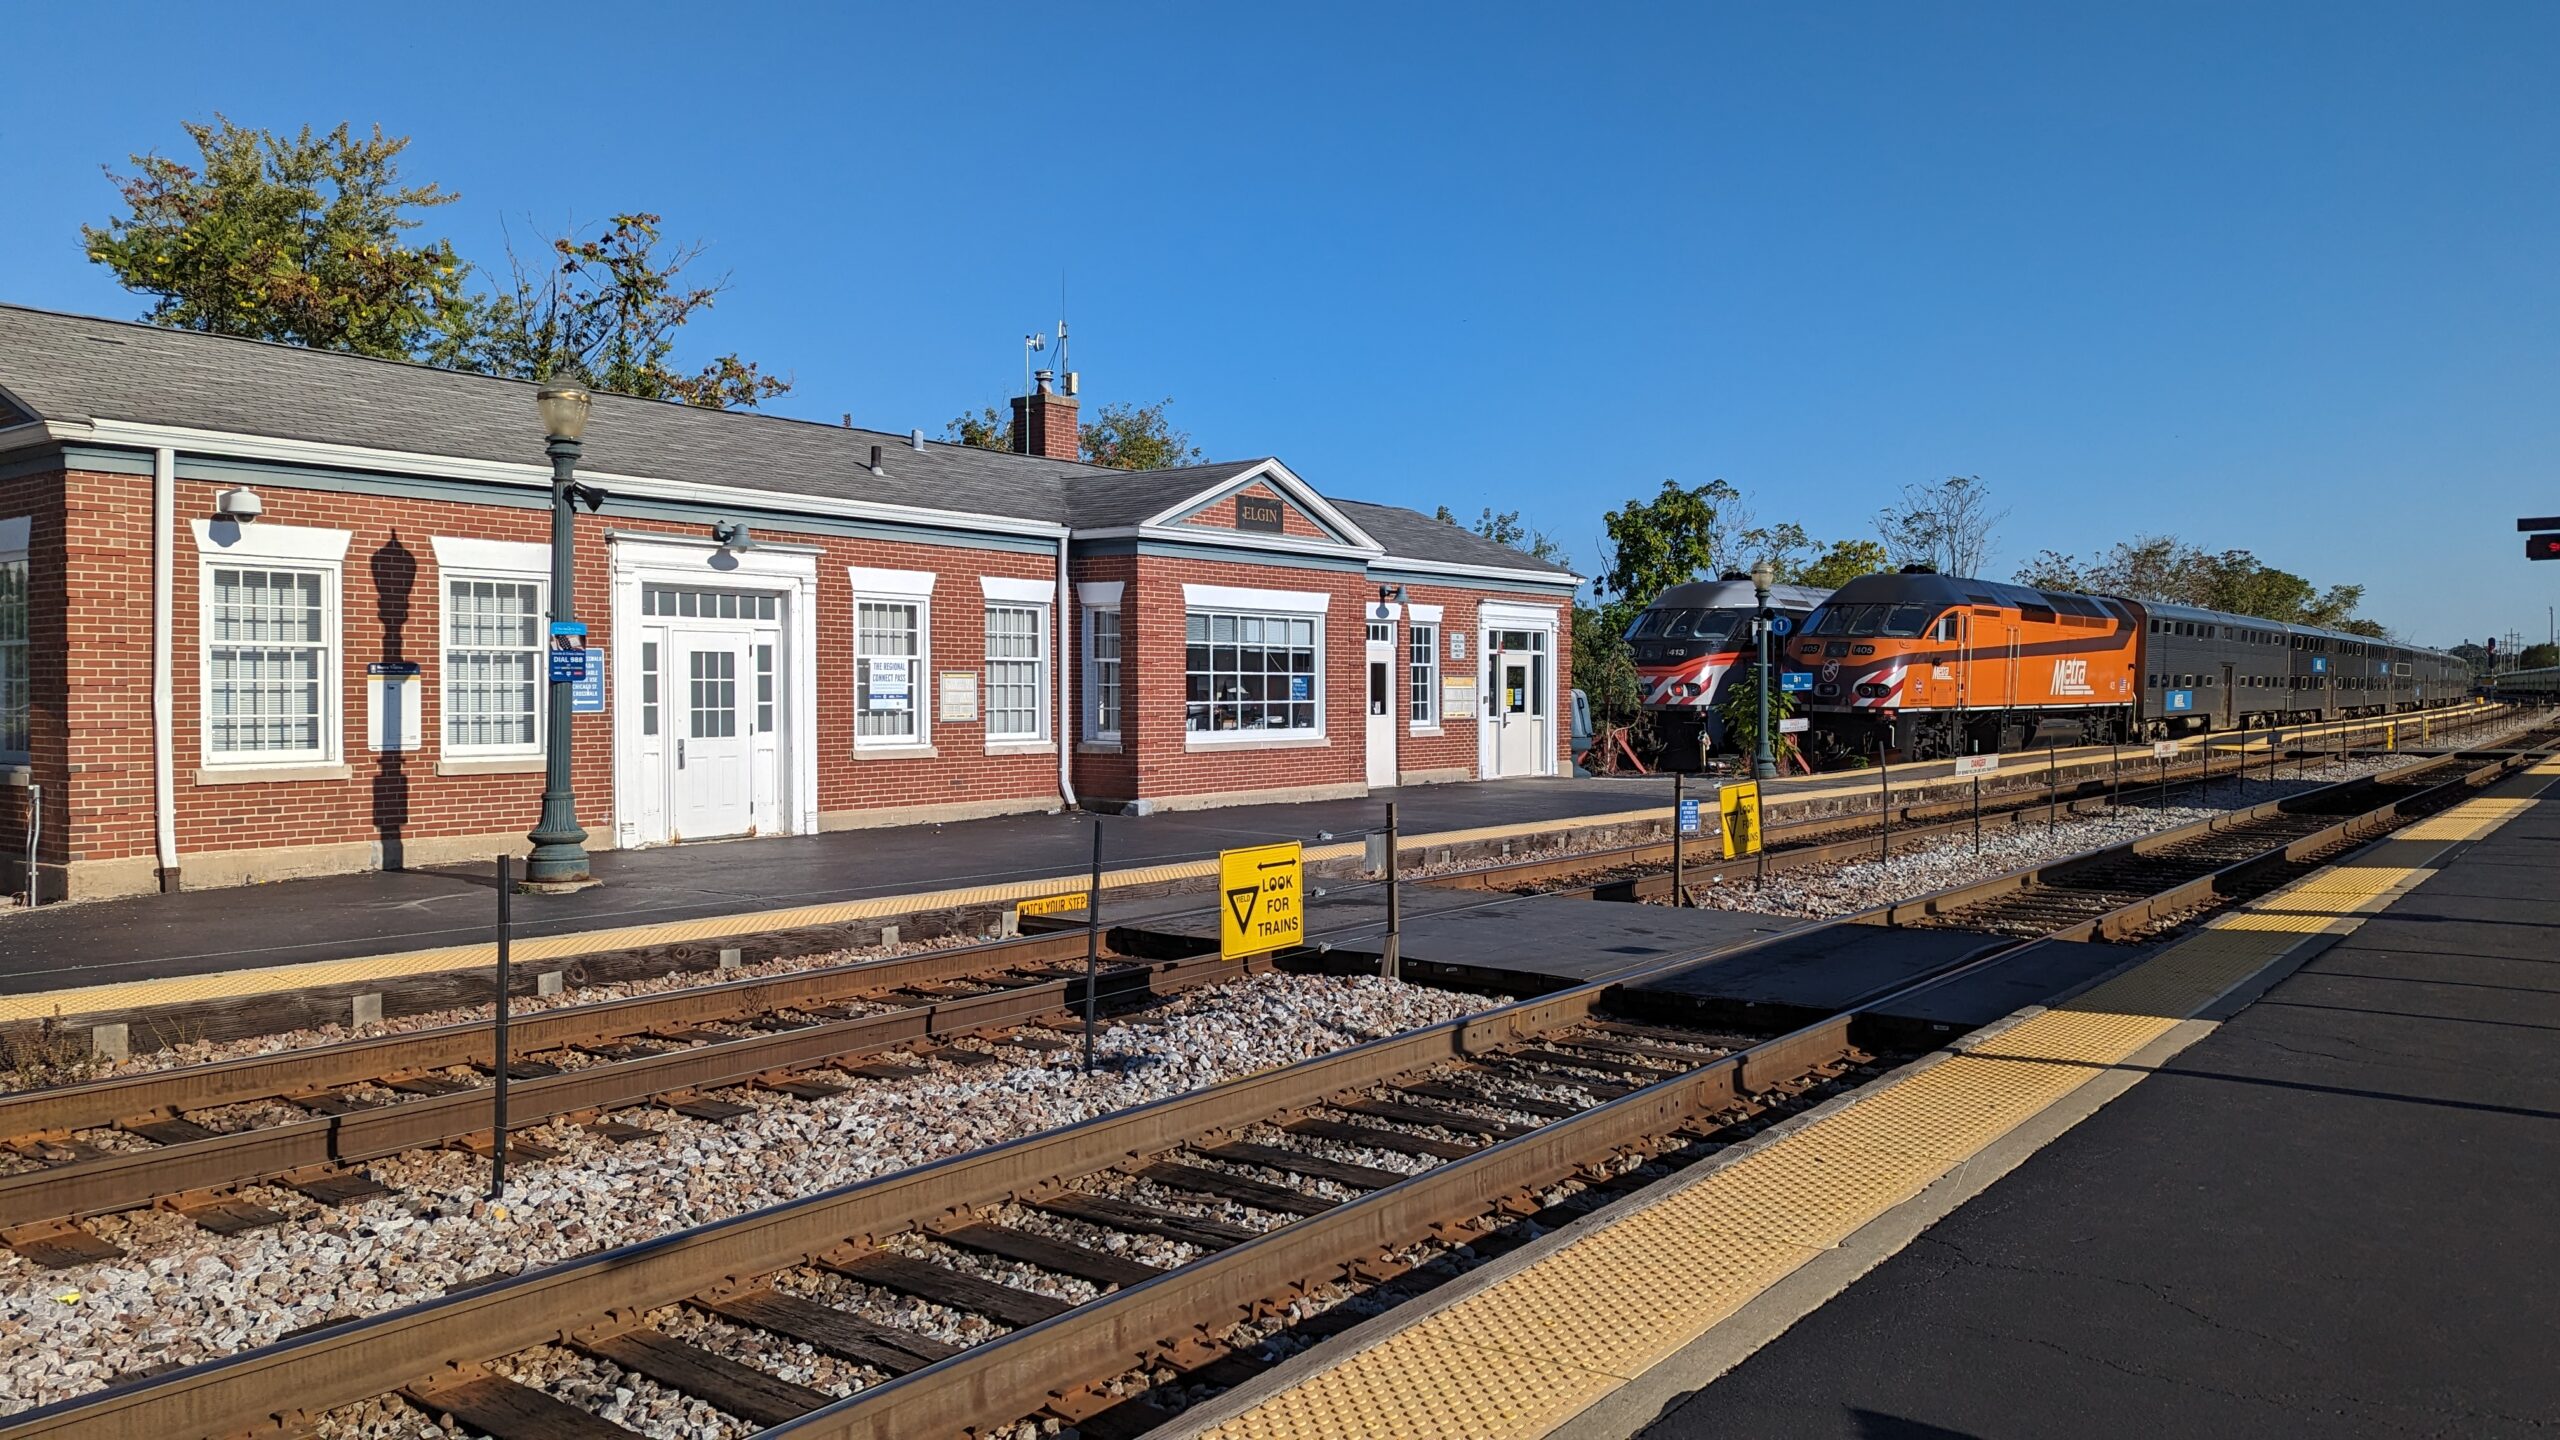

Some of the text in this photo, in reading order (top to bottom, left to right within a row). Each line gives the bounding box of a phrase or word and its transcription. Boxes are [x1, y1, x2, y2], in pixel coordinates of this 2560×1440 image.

[1244, 506, 1277, 523] ELGIN
[1778, 621, 1783, 631] 1
[1669, 648, 1685, 656] 413
[1856, 646, 1873, 654] 405
[874, 662, 906, 671] THE REGIONAL
[873, 673, 906, 682] CONNECT PASS
[2050, 656, 2091, 695] Metra
[1740, 804, 1755, 815] LOOK
[1742, 819, 1754, 829] FOR
[1738, 832, 1759, 844] TRAINS
[1262, 874, 1294, 893] LOOK
[1236, 894, 1251, 903] YIELD
[1019, 896, 1086, 916] WATCH YOUR STEP
[1267, 897, 1290, 914] FOR
[1258, 916, 1299, 937] TRAINS
